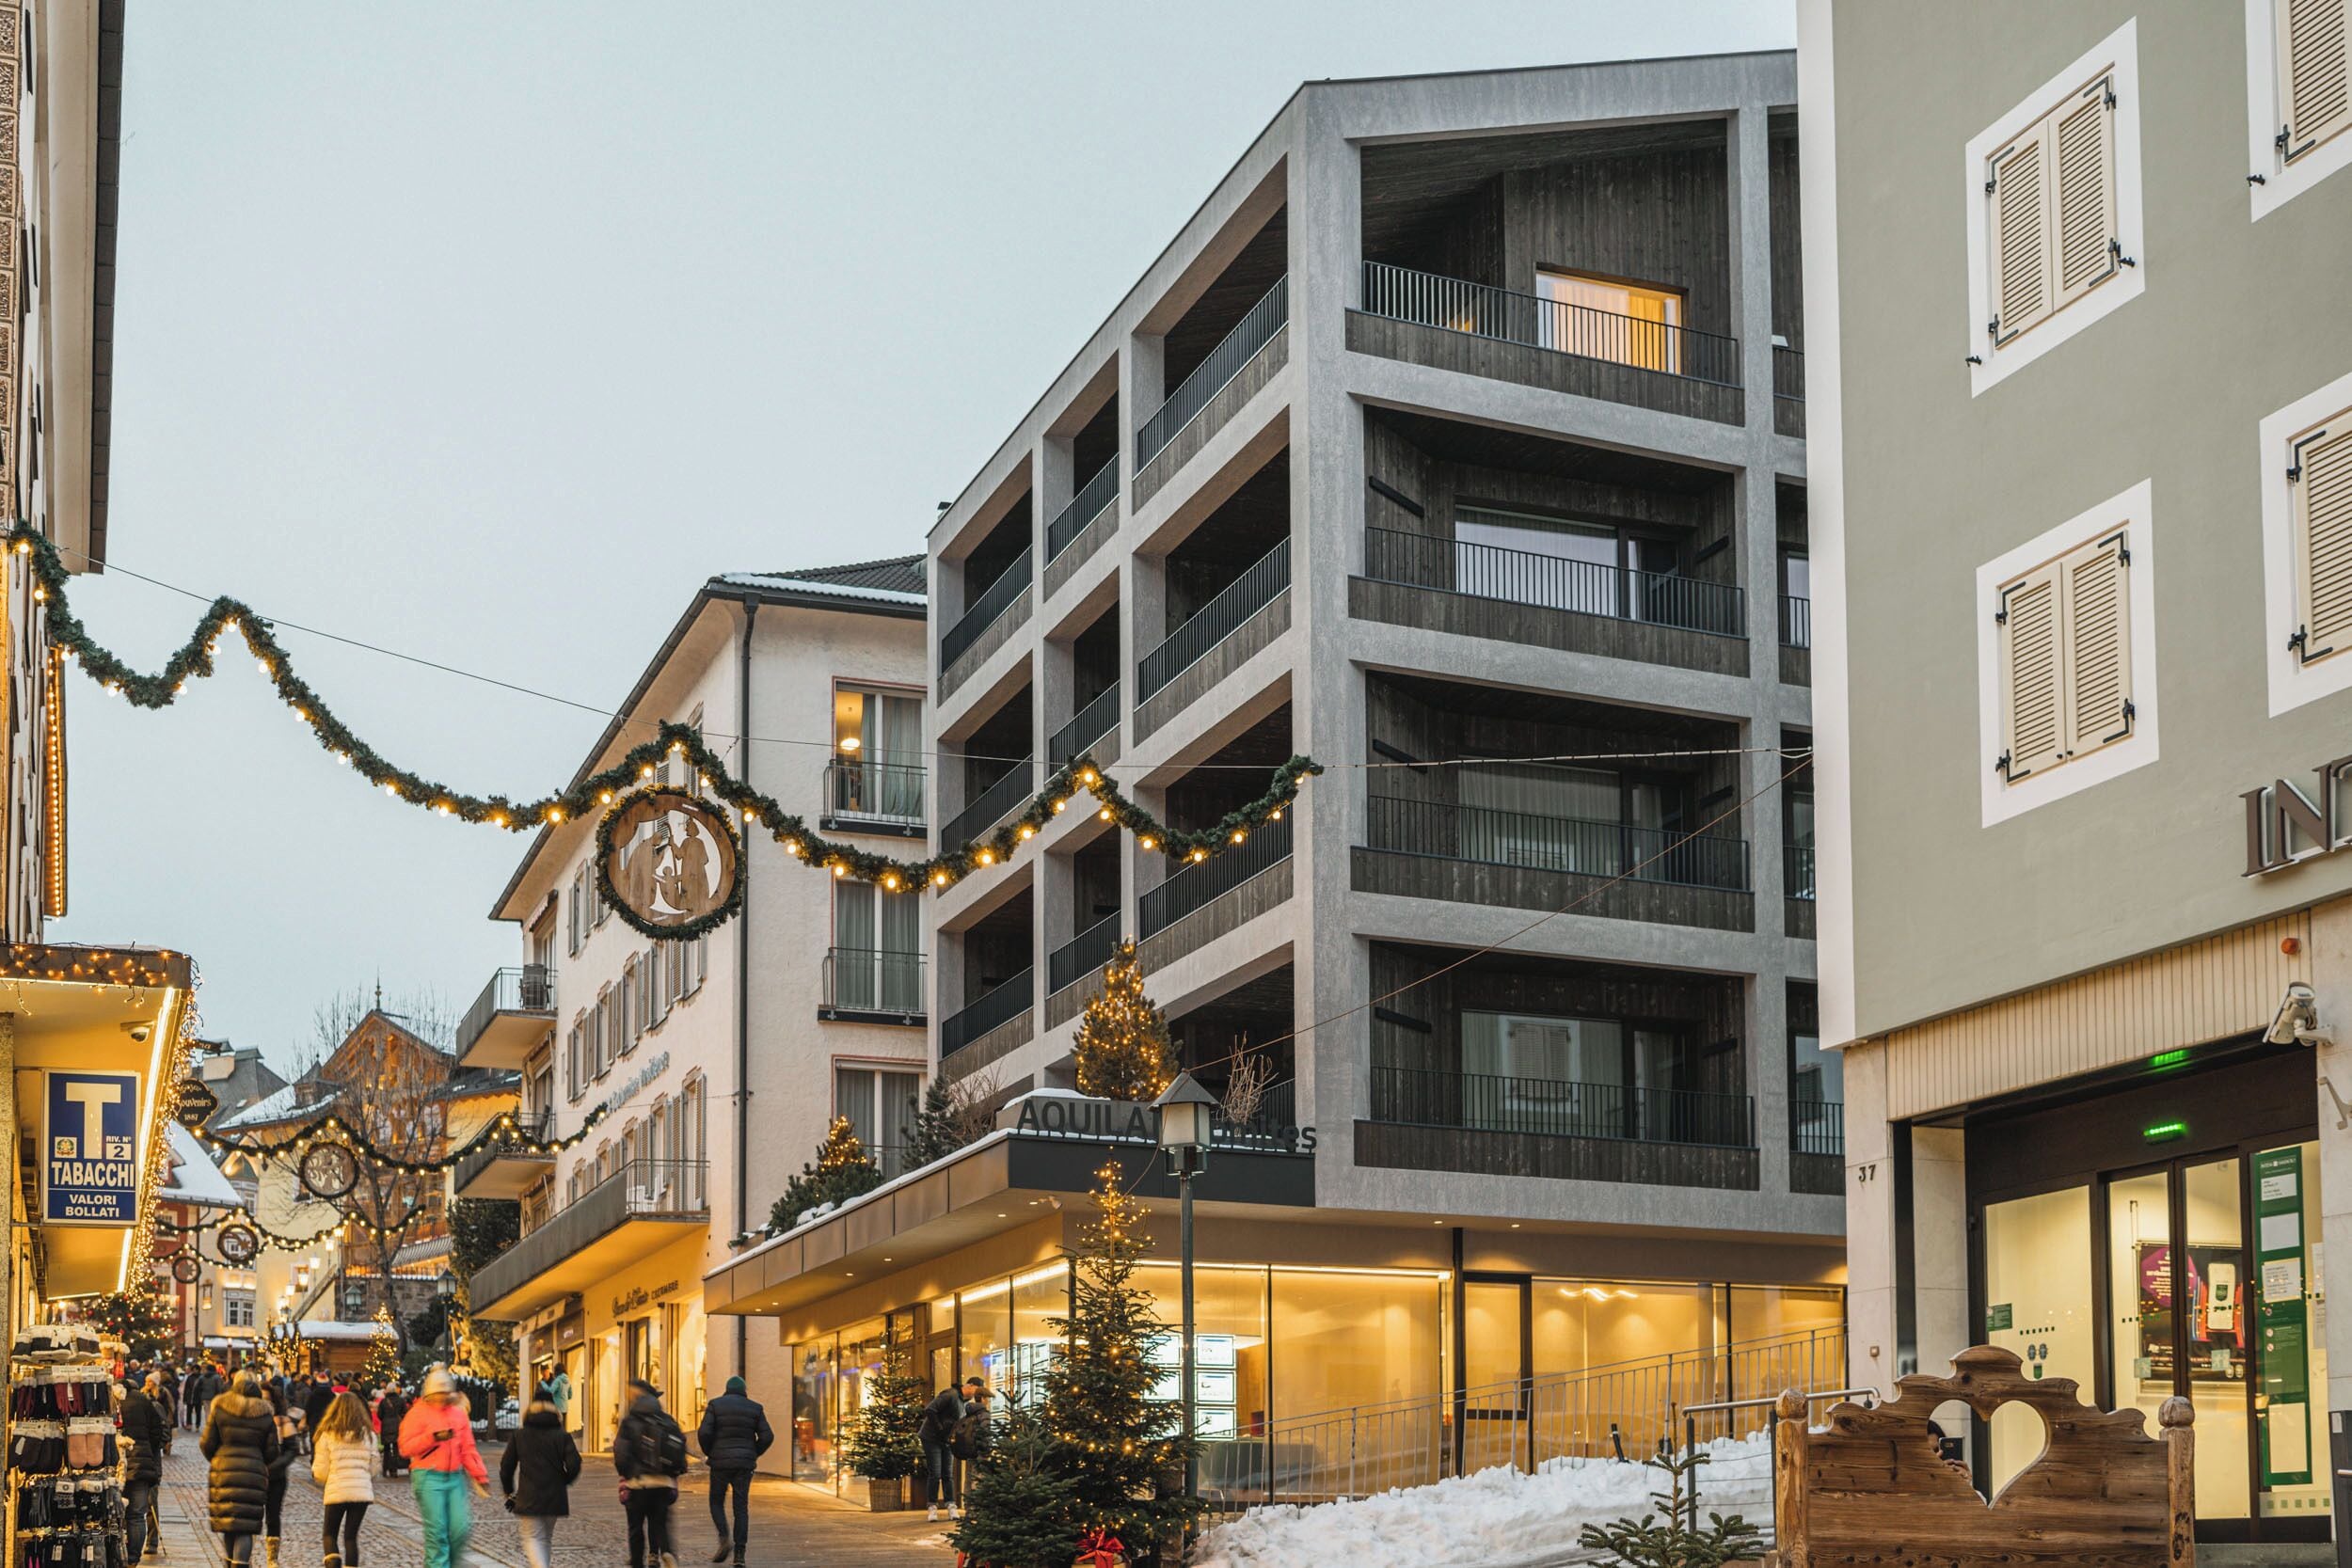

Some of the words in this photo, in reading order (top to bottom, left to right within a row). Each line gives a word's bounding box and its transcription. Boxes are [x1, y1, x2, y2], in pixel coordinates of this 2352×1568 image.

[66, 1082, 121, 1160] T
[1017, 1099, 1148, 1136] AQUILA
[113, 1145, 124, 1158] 2
[51, 1161, 135, 1187] TABACCHI
[1859, 1164, 1876, 1182] 37
[69, 1194, 117, 1205] VALORI
[65, 1206, 119, 1217] BOLLATI
